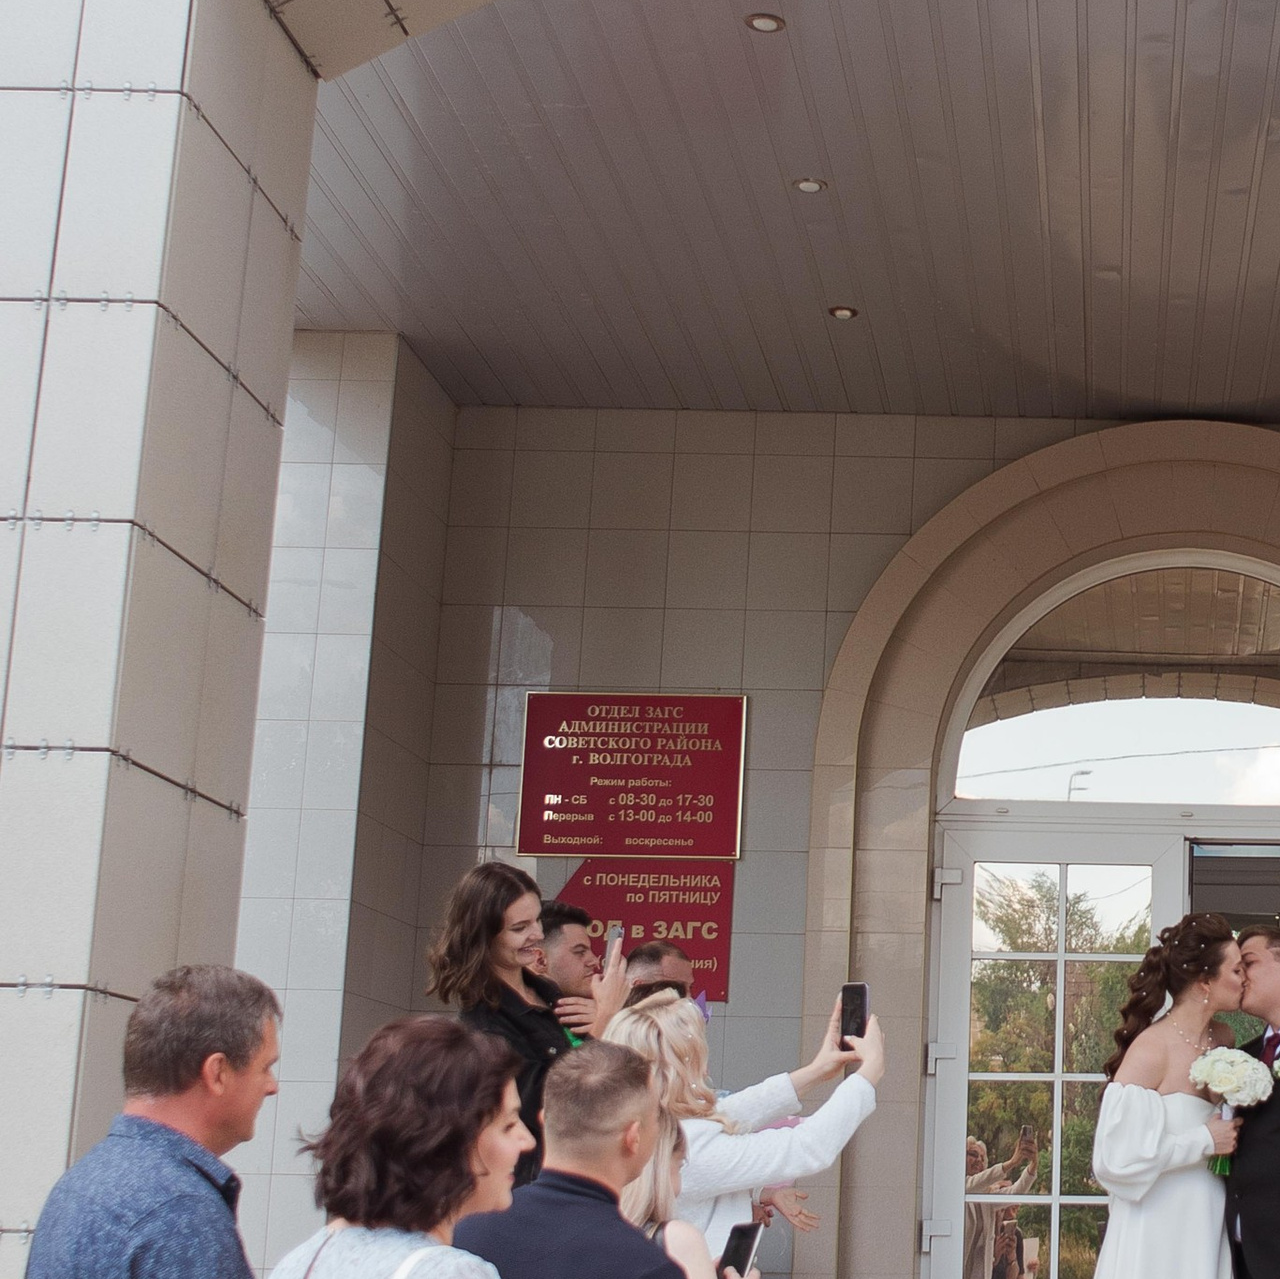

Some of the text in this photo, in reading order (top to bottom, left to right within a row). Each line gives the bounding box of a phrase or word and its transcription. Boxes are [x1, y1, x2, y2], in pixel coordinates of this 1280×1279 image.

[587, 705, 684, 719] ОТДЕЛ ЗАГС
[558, 720, 710, 735] АДМИНИСТРАЦИИ
[543, 735, 723, 751] СОВЕТСКОГО РАЙОНА
[572, 752, 692, 768] г. ВОЛГОГРАДА
[590, 776, 672, 788] Режим работы:
[544, 794, 562, 805] ПН
[571, 795, 588, 804] СБ
[618, 793, 657, 806] 08-30
[658, 797, 673, 807] до
[676, 794, 714, 806] 17-30
[543, 810, 594, 822] Перерыв
[618, 809, 656, 822] 13-00
[658, 813, 673, 823] до
[676, 811, 713, 823] 14-00
[543, 834, 694, 847] Выходной: воскресенье
[583, 873, 721, 888] с ПОНЕДЕЛЬНИКА
[626, 890, 721, 906] по ПЯТНИЦУ
[631, 924, 645, 938] в
[652, 920, 719, 940] ЗАГС
